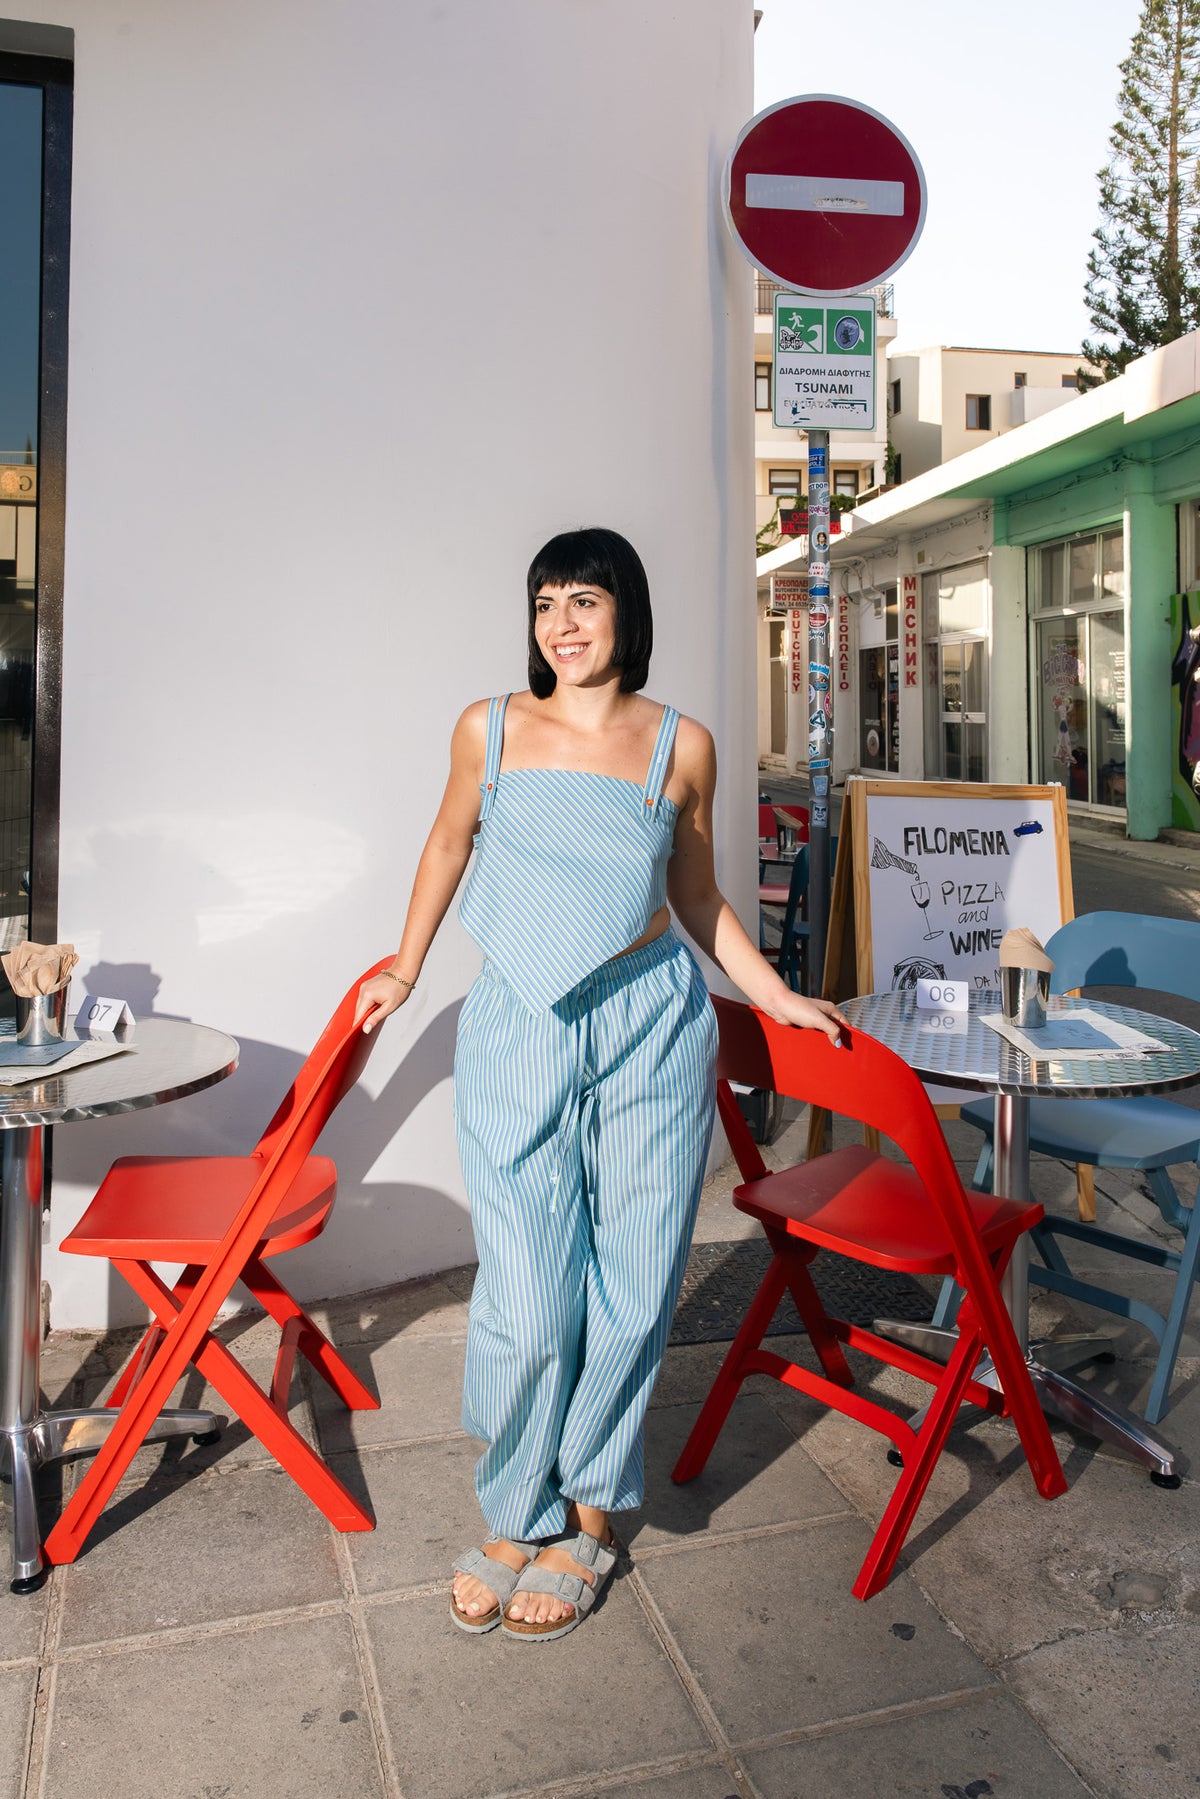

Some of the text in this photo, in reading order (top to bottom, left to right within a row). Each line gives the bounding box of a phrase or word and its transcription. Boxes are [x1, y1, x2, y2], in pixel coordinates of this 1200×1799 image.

[779, 367, 871, 378] ΔΙΑΔΡΟΜΗ ΔΙΑΦΥΓΗΣ
[795, 382, 853, 395] TSUNAMI
[838, 595, 849, 691] ΚΡΕΟΠΩΛΕΙΟ
[903, 576, 917, 686] МЯСНИК
[791, 609, 801, 693] BUTCHERY
[903, 826, 1010, 857] FILOMENA
[941, 880, 1006, 907] PIZZA
[958, 906, 990, 925] and
[949, 928, 1003, 956] WINE
[929, 985, 956, 1004] 06
[87, 1003, 112, 1022] 07
